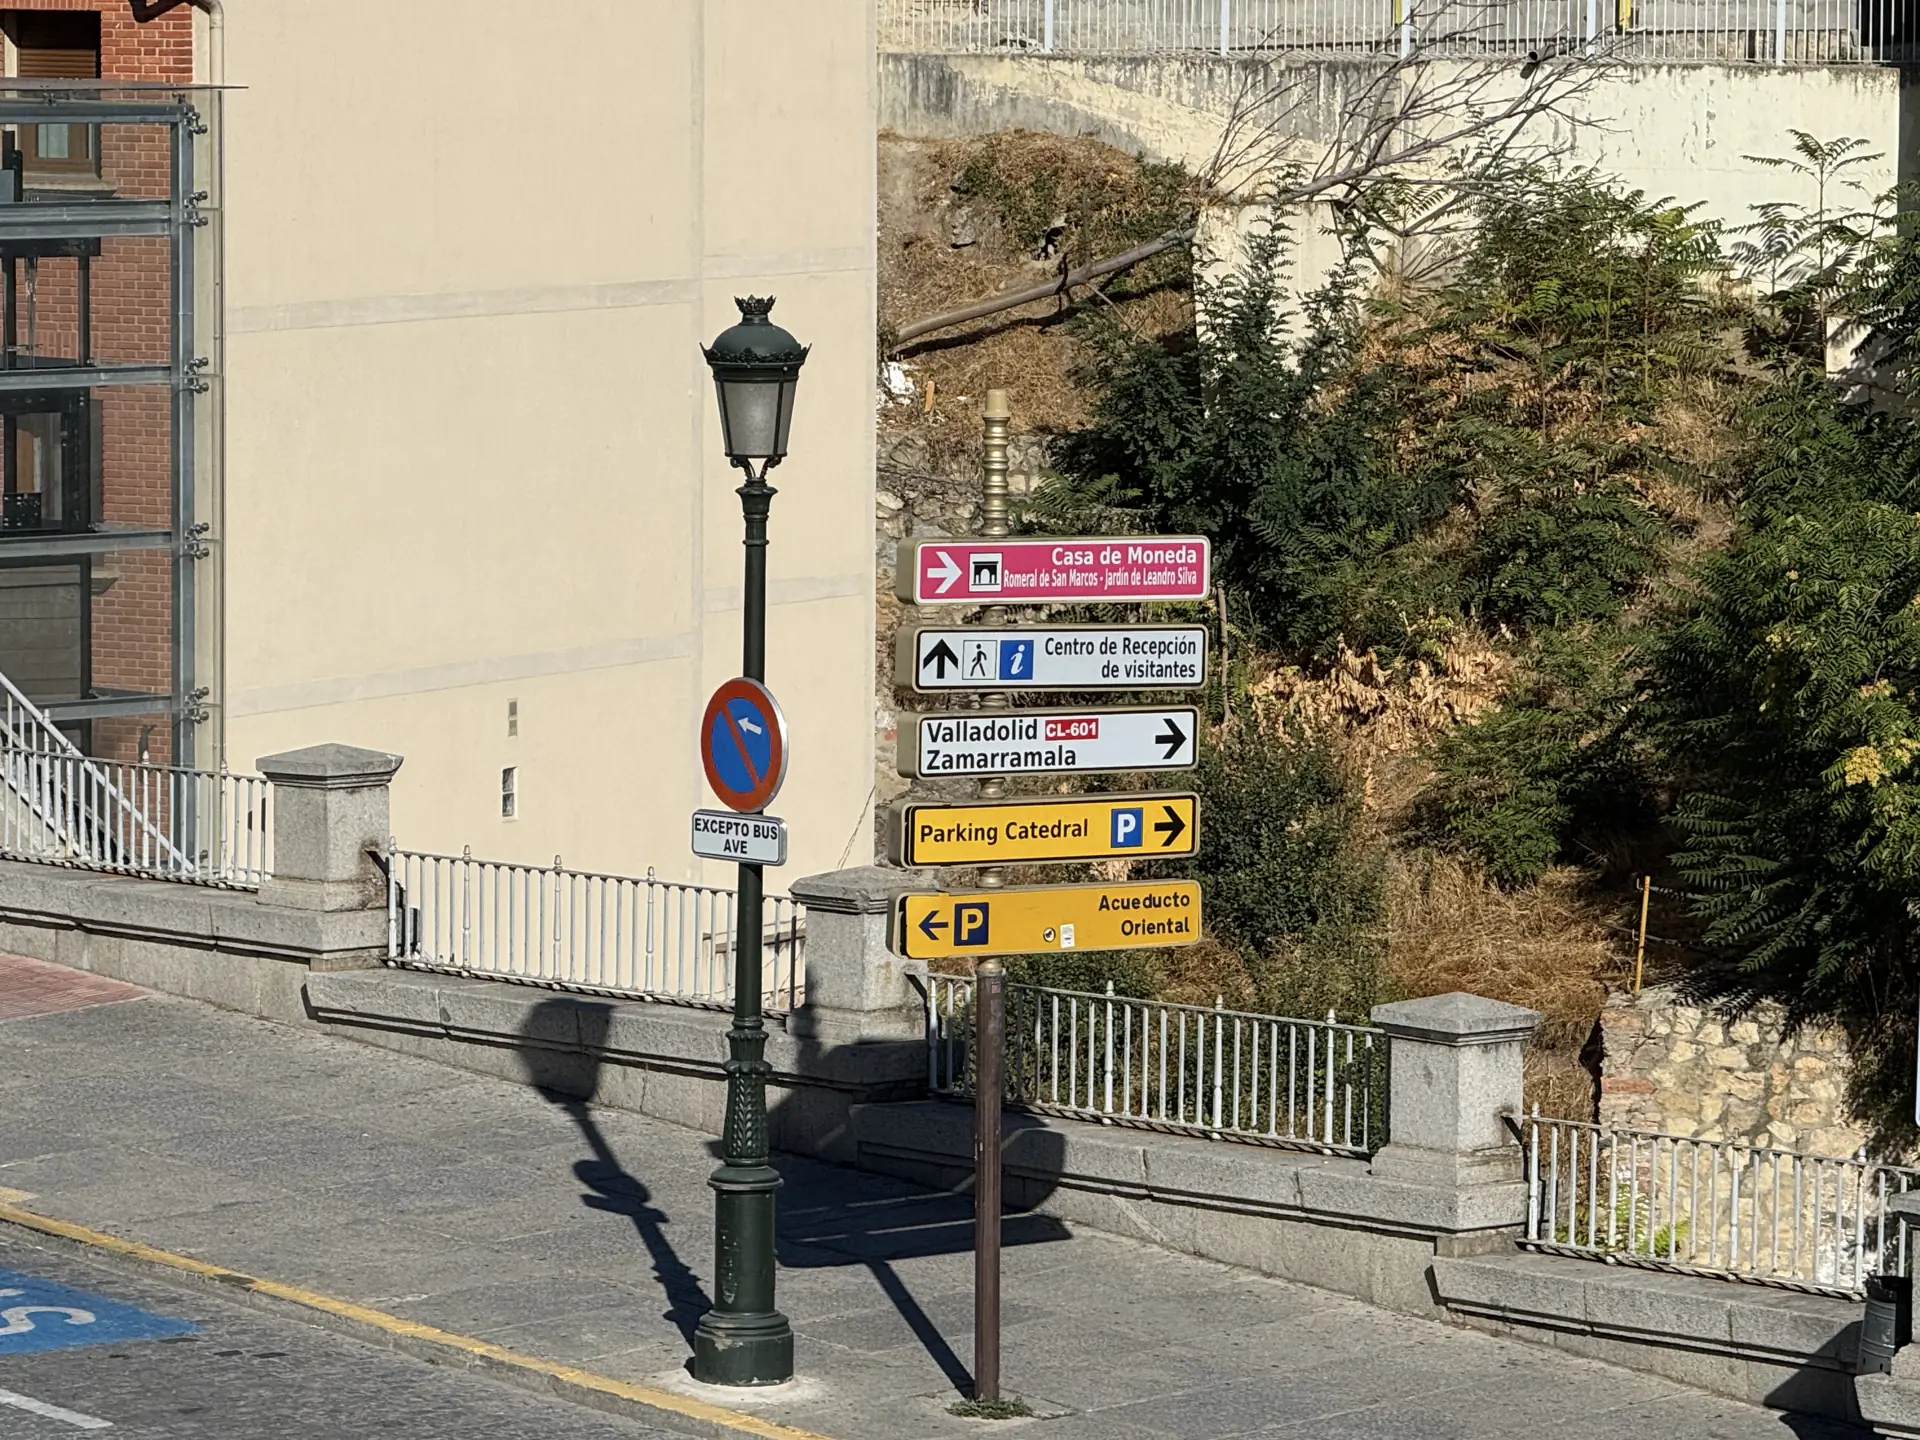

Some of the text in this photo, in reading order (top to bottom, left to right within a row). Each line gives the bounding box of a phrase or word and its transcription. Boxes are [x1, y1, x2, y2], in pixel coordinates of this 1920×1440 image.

[1052, 545, 1197, 566] Casa de Moneda
[1003, 568, 1038, 588] Romeral
[1039, 568, 1050, 587] de
[1051, 568, 1067, 587] San
[1069, 568, 1098, 587] Marcos
[1104, 566, 1129, 590] Jardín
[1130, 567, 1141, 585] de
[1143, 566, 1176, 585] Leandro
[1177, 566, 1197, 585] Silva
[1045, 635, 1197, 659] Centro de Recepción
[1101, 660, 1196, 678] de visitantes
[926, 718, 1097, 743] Valladolid CL-601
[926, 745, 1077, 771] Zamarramala
[694, 818, 778, 840] EXCEPTO BUS
[919, 818, 1088, 845] Parking Catedral
[1116, 813, 1136, 843] P
[723, 838, 748, 855] AVE
[1098, 891, 1191, 912] Acueducto
[960, 908, 984, 941] P
[1121, 917, 1190, 937] Oriental
